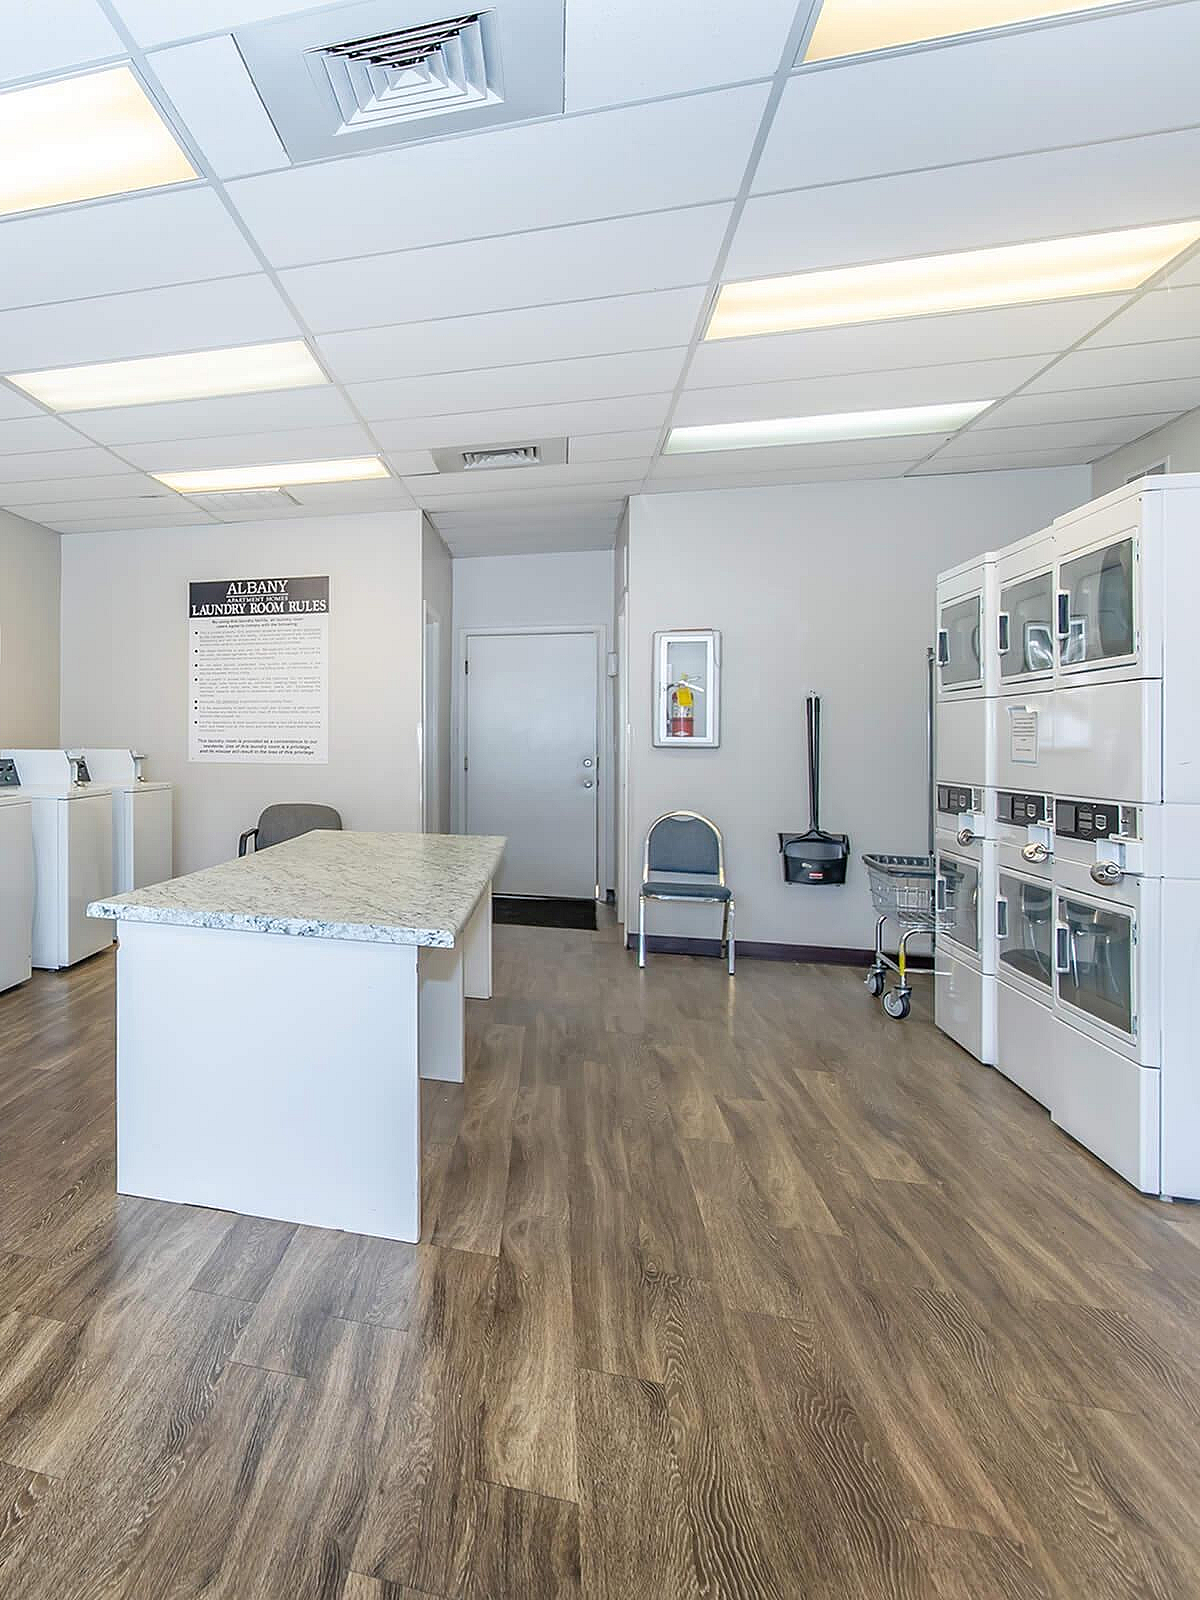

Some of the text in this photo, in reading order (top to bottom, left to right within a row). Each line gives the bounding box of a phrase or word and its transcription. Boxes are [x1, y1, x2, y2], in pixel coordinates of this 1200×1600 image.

[226, 580, 288, 595] ALBANY
[192, 600, 327, 616] LAUNDRY ROOM RULES
